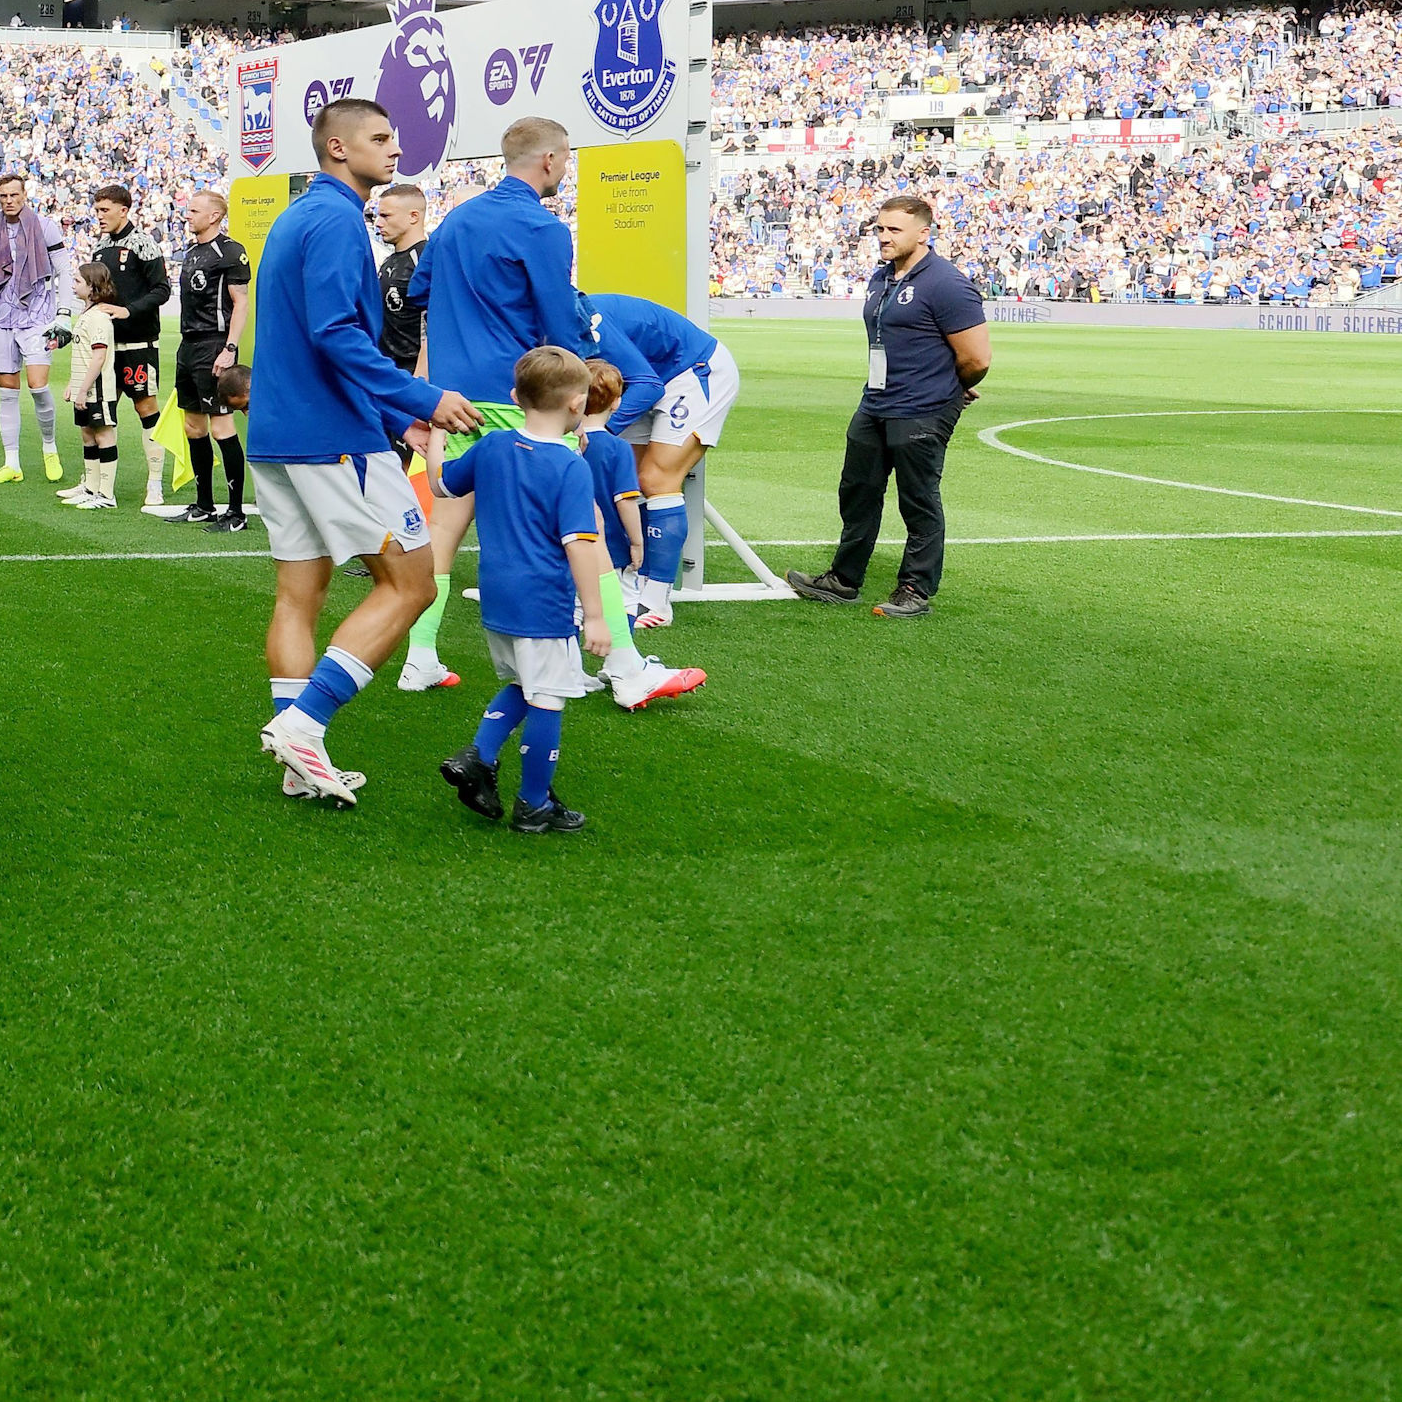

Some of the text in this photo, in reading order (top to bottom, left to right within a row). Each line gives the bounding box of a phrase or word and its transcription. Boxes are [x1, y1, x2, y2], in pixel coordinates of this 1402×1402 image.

[40, 3, 55, 15] 236
[489, 60, 513, 82] EA
[602, 68, 654, 89] Everton
[488, 79, 514, 92] SPORTS
[619, 89, 636, 102] 1878
[585, 79, 672, 127] NIL SATIS NISI OPTIMUM
[929, 100, 944, 113] 119
[1125, 135, 1159, 143] TOWN
[1160, 135, 1176, 143] FC
[600, 170, 660, 183] Premier League
[612, 186, 648, 198] Live from
[618, 202, 654, 214] Dickinson
[614, 218, 646, 229] Stadium
[994, 307, 1037, 323] SCIENCE
[1258, 314, 1308, 331] SCHOOL
[1316, 315, 1332, 332] OF
[123, 364, 148, 385] 26
[670, 395, 690, 420] 6
